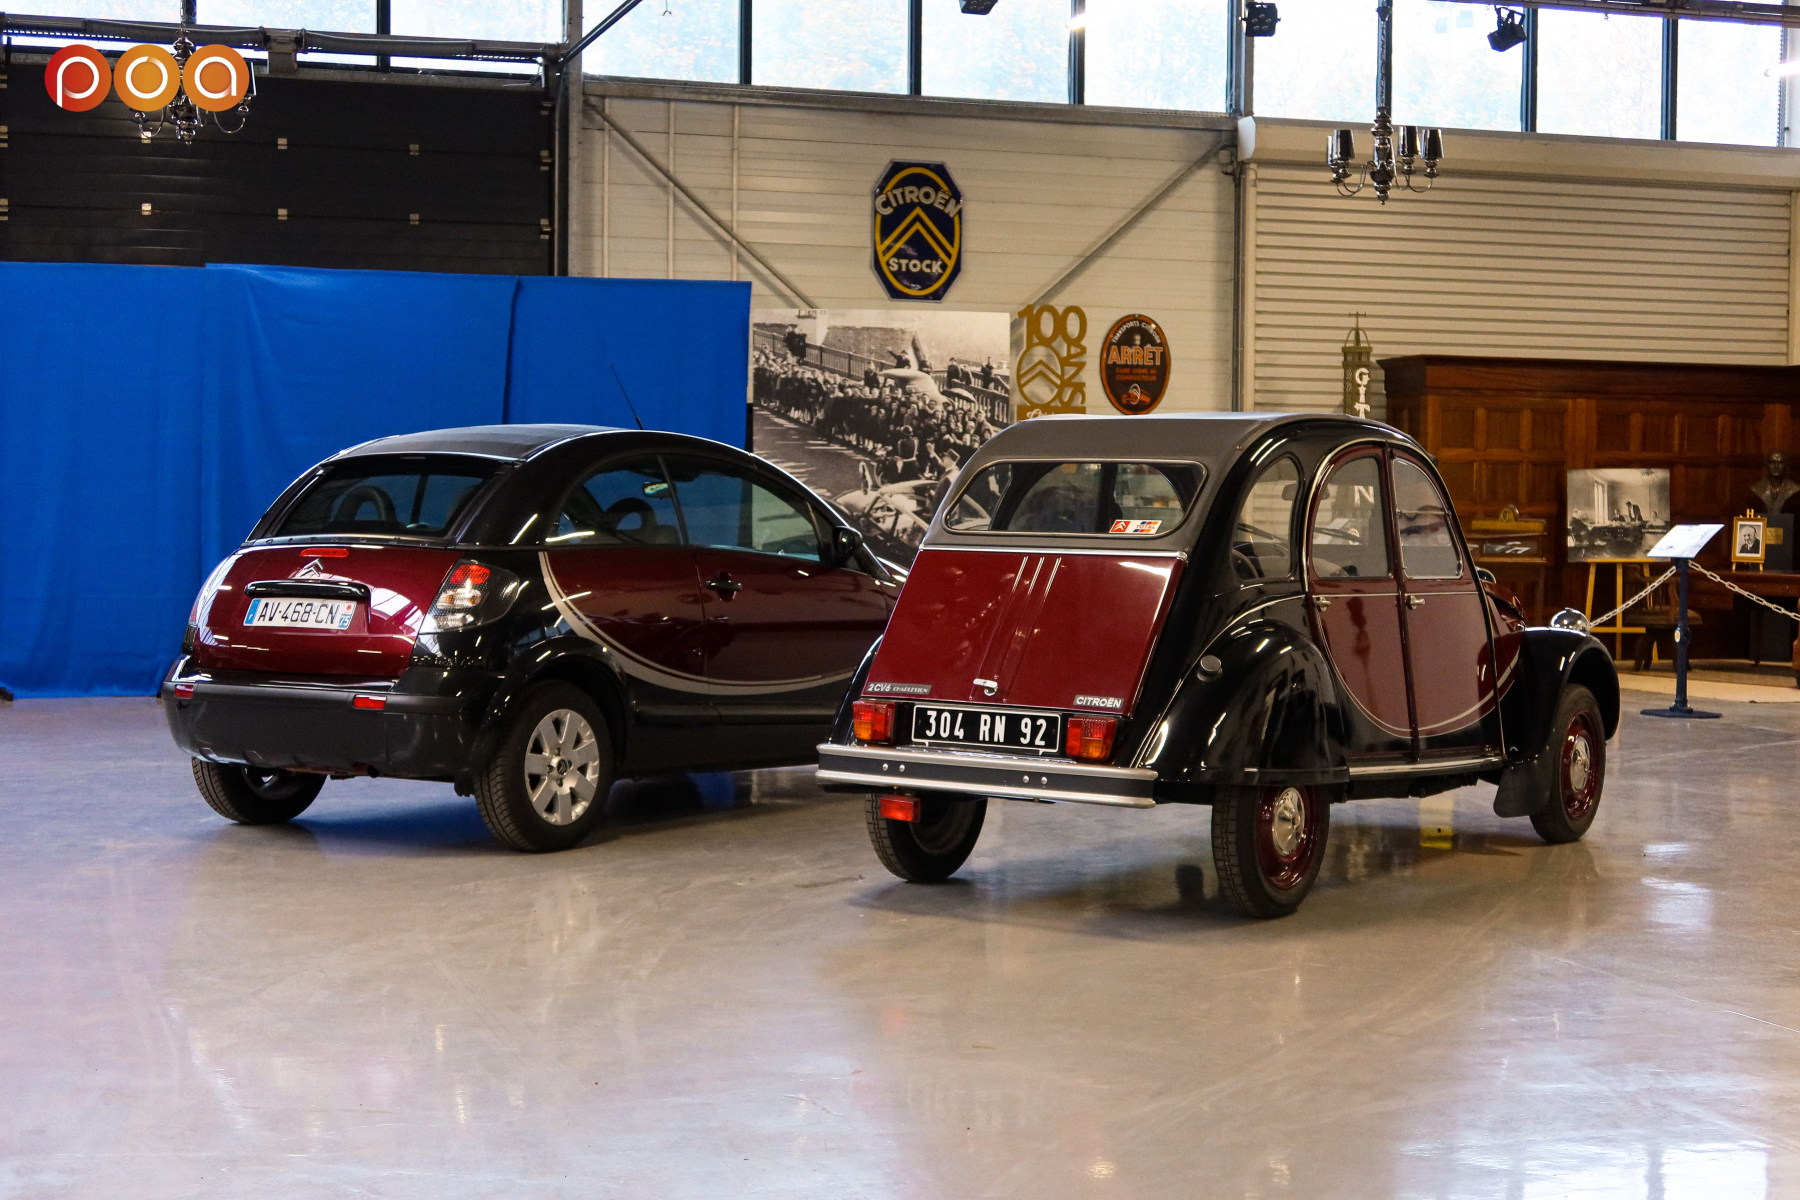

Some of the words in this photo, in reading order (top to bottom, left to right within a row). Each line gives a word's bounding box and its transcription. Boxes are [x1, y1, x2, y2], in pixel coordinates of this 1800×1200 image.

[875, 184, 962, 218] CITROËN
[888, 257, 944, 273] STOCK
[1017, 304, 1087, 347] 100
[1107, 343, 1163, 366] ARRÊT
[1060, 342, 1087, 405] ANS
[257, 602, 340, 624] AV-468-CN
[340, 615, 351, 626] 75
[867, 683, 891, 692] 2CV6
[1076, 696, 1121, 708] CITROËN
[925, 710, 964, 740] 304
[979, 714, 1006, 743] RN
[1019, 717, 1047, 746] 92
